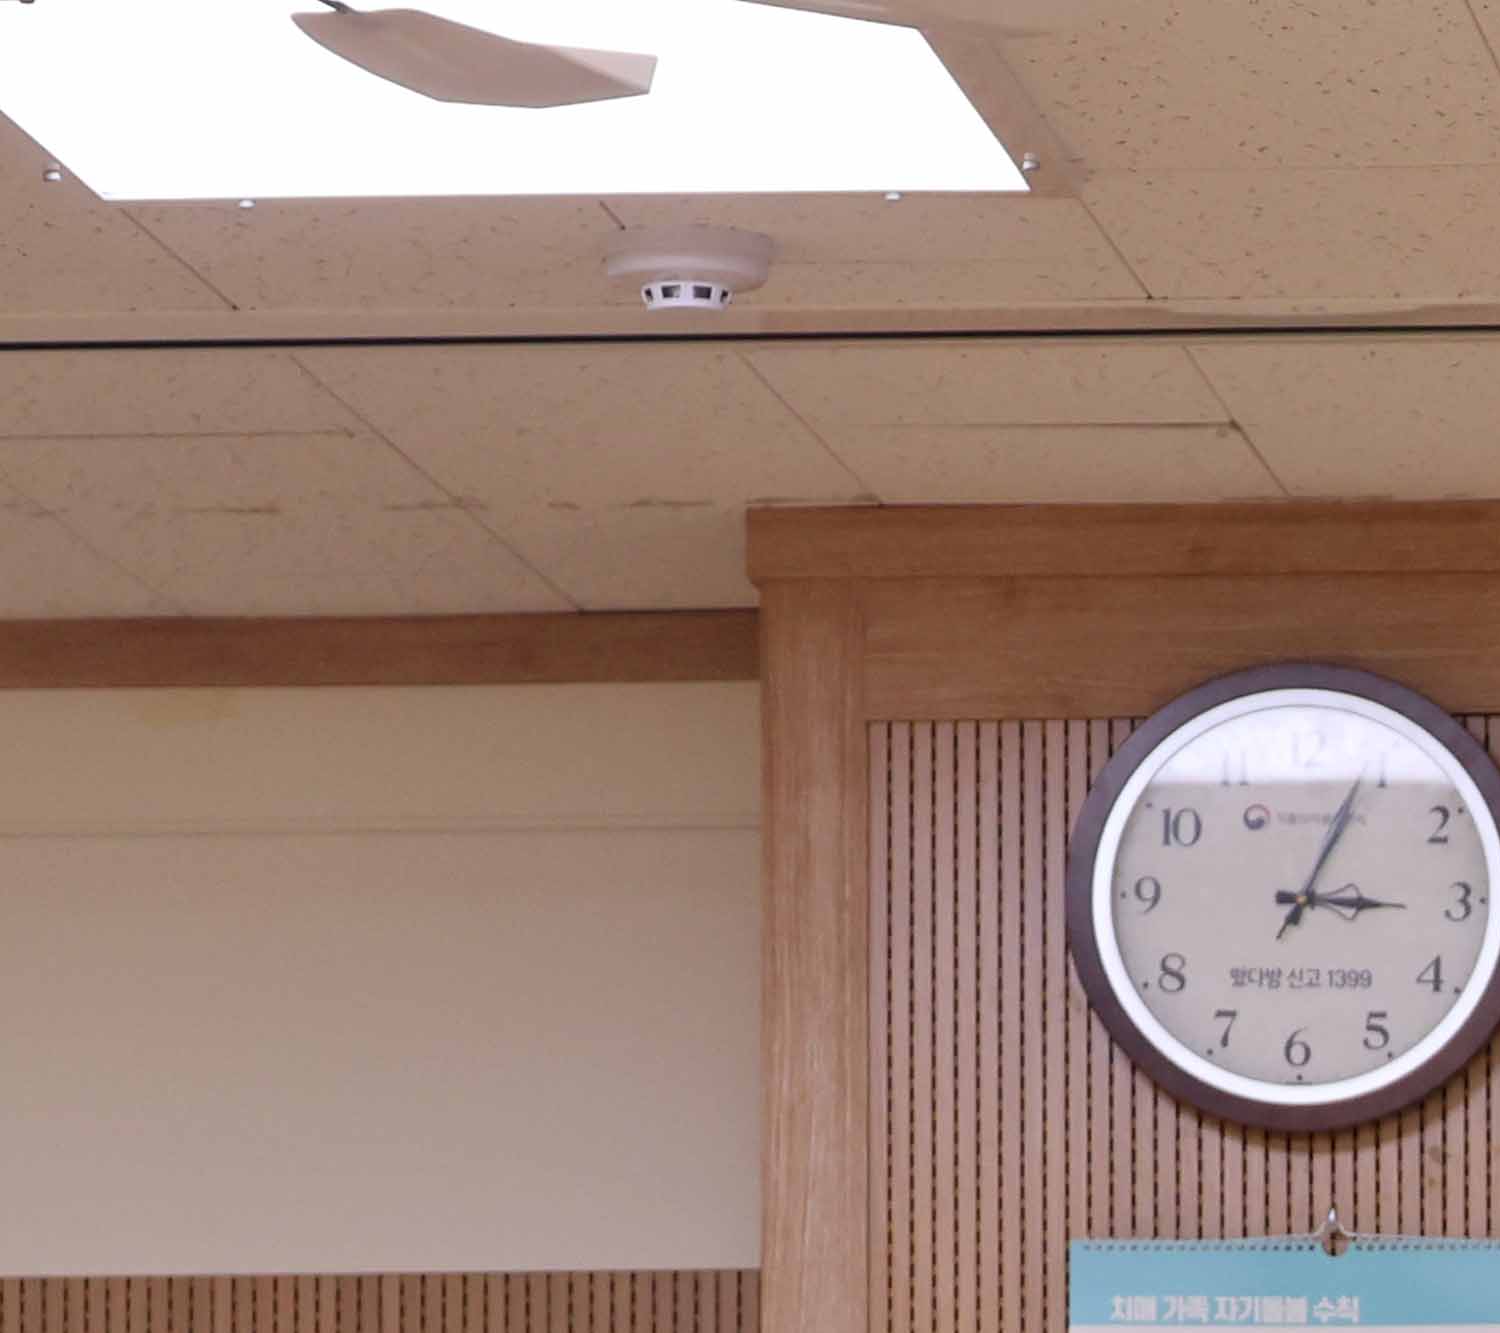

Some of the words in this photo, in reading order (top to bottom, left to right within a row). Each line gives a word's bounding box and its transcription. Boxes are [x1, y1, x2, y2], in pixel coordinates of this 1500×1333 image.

[1162, 808, 1203, 847] 10
[1427, 805, 1451, 845] 2
[1133, 877, 1161, 913] 9
[1444, 881, 1472, 922] 3
[1158, 953, 1187, 993] 8
[1287, 967, 1321, 989] 신고
[1327, 968, 1373, 989] 1399
[1416, 955, 1444, 993] 4
[1213, 1009, 1238, 1047] 7
[1362, 1011, 1390, 1050] 5
[1284, 1030, 1312, 1067] 6
